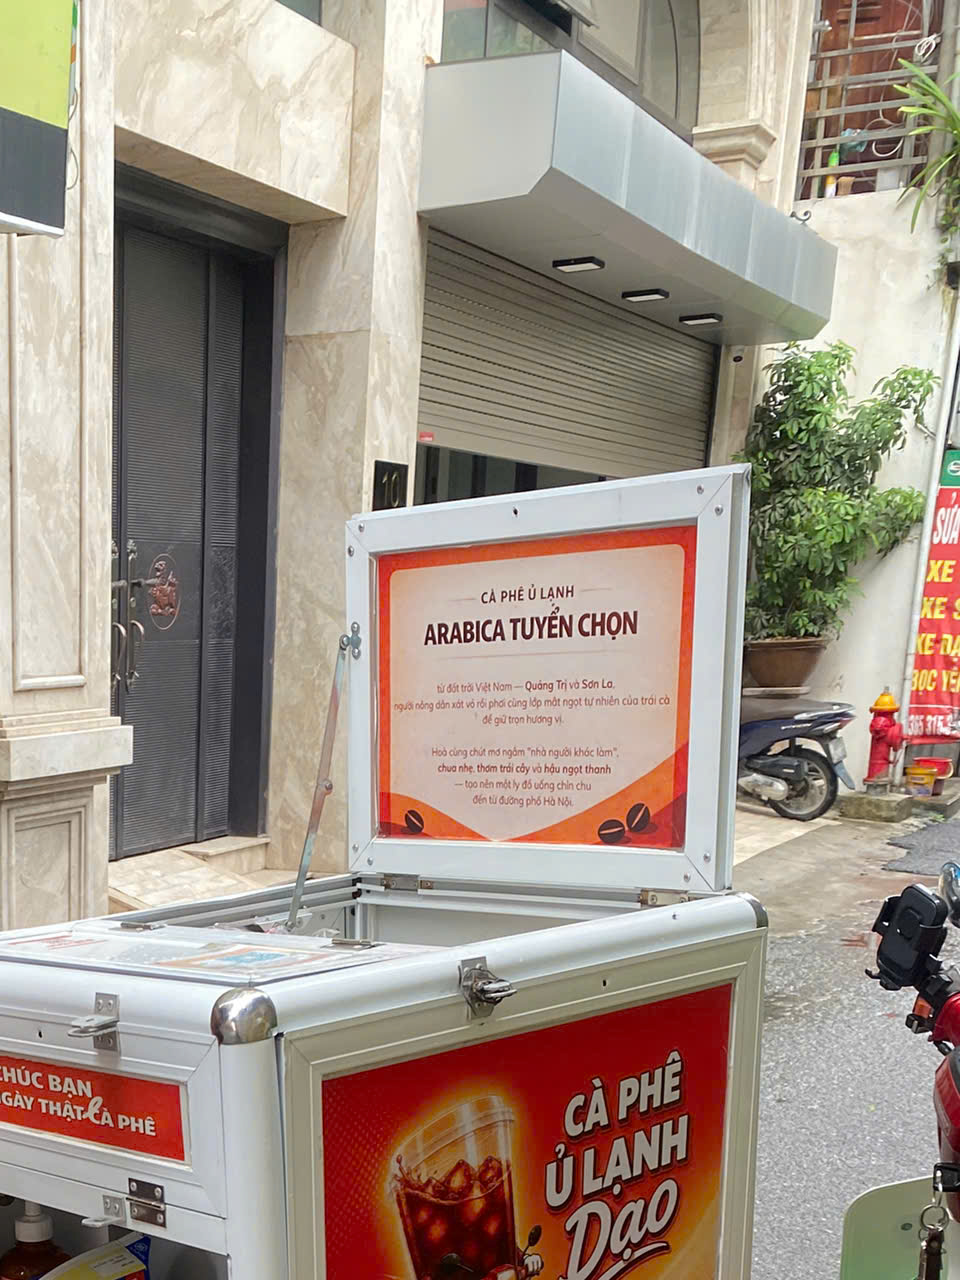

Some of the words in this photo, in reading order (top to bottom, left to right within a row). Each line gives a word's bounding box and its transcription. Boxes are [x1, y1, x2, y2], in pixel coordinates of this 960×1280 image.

[382, 472, 399, 508] 10
[926, 560, 957, 583] XE
[481, 588, 496, 604] CÀ
[501, 586, 524, 602] PHÊ
[528, 584, 536, 600] Ủ
[540, 585, 575, 602] LẠNH
[920, 596, 948, 620] XE
[424, 618, 506, 646] ARABICA
[509, 604, 573, 641] TUYỂN
[578, 611, 638, 640] CHỌN
[916, 633, 937, 656] XE
[493, 682, 512, 692] Nam
[525, 680, 554, 693] Quảng
[557, 679, 567, 691] Trị
[569, 680, 579, 689] và
[582, 679, 599, 689] Sơn
[942, 665, 960, 693] YÊ
[641, 695, 657, 705] trái
[438, 763, 457, 773] chua
[477, 763, 498, 773] thơm
[500, 763, 514, 773] trái
[516, 763, 530, 775] cây
[562, 764, 583, 776] ngọt
[585, 764, 611, 774] thanh
[513, 780, 520, 792] ly
[576, 780, 592, 791] chu
[544, 797, 555, 806] Hà
[48, 1074, 93, 1099] BẠN
[564, 1078, 609, 1138] CÀ
[618, 1050, 683, 1120] PHÊ
[38, 1097, 84, 1123] THẬT
[118, 1115, 157, 1137] PHÊ
[545, 1143, 574, 1208] Ủ
[582, 1115, 689, 1197] LẠNH
